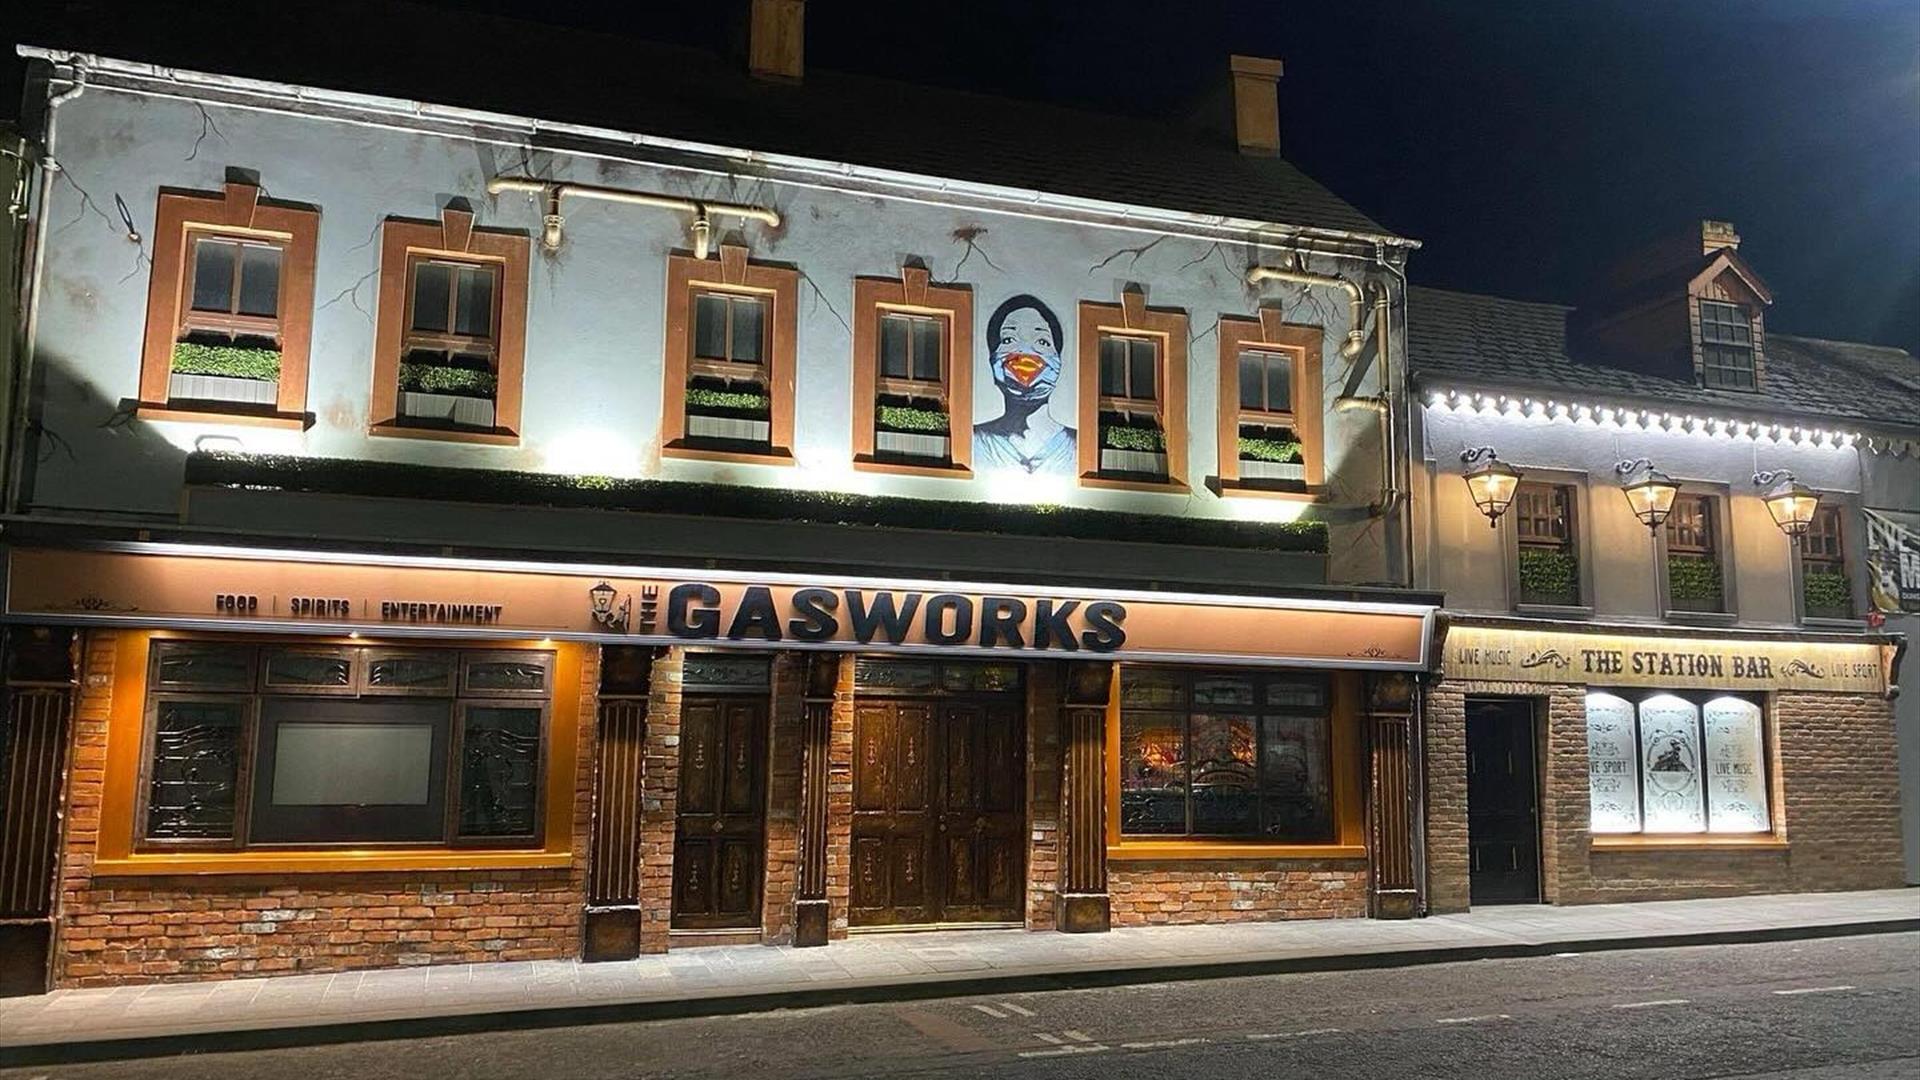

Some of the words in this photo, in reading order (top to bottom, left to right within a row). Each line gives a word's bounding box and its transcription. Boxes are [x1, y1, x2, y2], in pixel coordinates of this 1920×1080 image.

[216, 594, 258, 611] FOOD
[291, 598, 350, 616] SPIRITS
[382, 602, 502, 624] ENTERTAINMENT
[639, 584, 659, 635] THE
[667, 583, 1127, 652] GASWORKS
[1459, 648, 1479, 665] LIVE
[1484, 648, 1511, 665] MUSIC
[1581, 649, 1623, 674] THE
[1632, 652, 1723, 678] STATION
[1732, 655, 1774, 679] BAR
[1831, 662, 1849, 678] LIVE
[1852, 663, 1877, 678] SPORT
[1602, 761, 1626, 773] SPORT
[1715, 762, 1731, 775] LIVE
